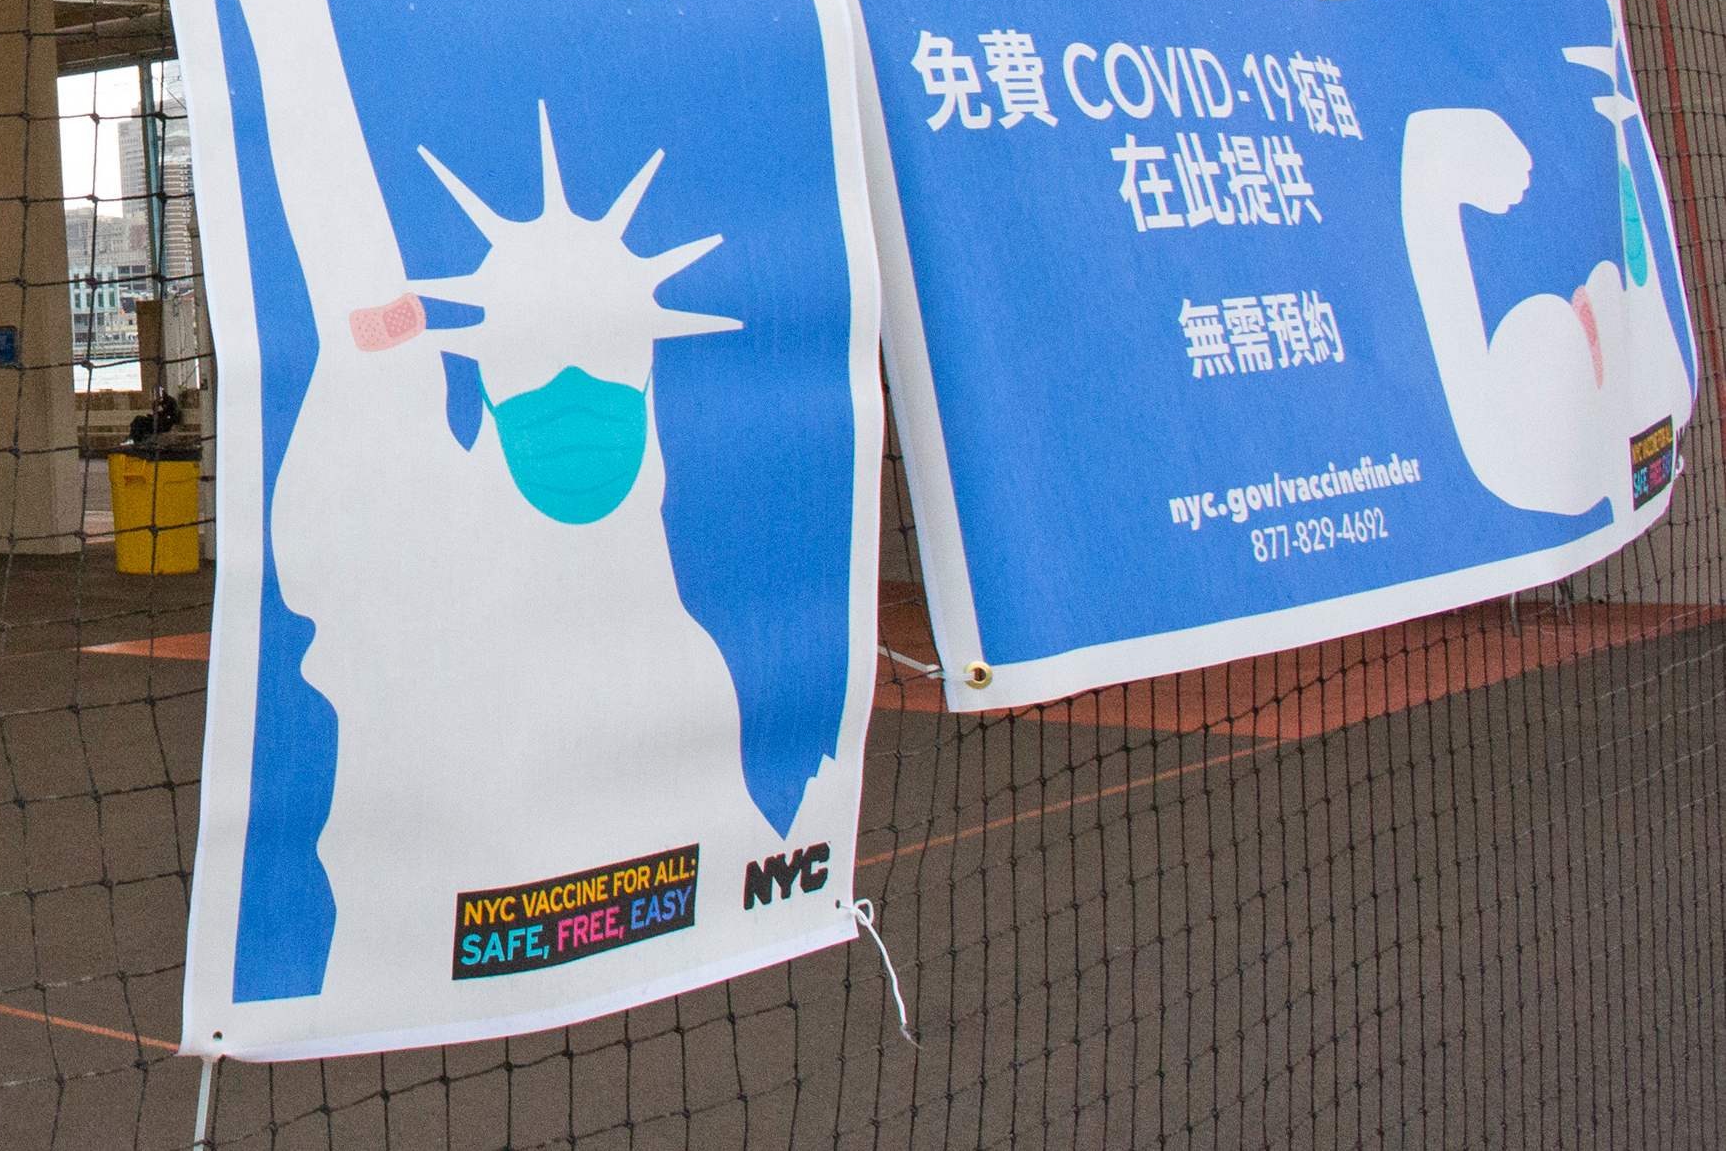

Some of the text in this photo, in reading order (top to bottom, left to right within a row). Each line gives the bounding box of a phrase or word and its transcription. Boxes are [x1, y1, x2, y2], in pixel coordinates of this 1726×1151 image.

[1110, 132, 1323, 233] 在此提供
[1178, 290, 1346, 379] 無需預約
[1169, 453, 1422, 531] nyc.gov/vaccinefinder
[1251, 507, 1389, 562] 877-829-4692
[463, 855, 697, 927] NYC VACCINE FOR ALL:
[743, 841, 831, 911] NYC
[461, 885, 693, 966] SAFE, FREE, EASY
